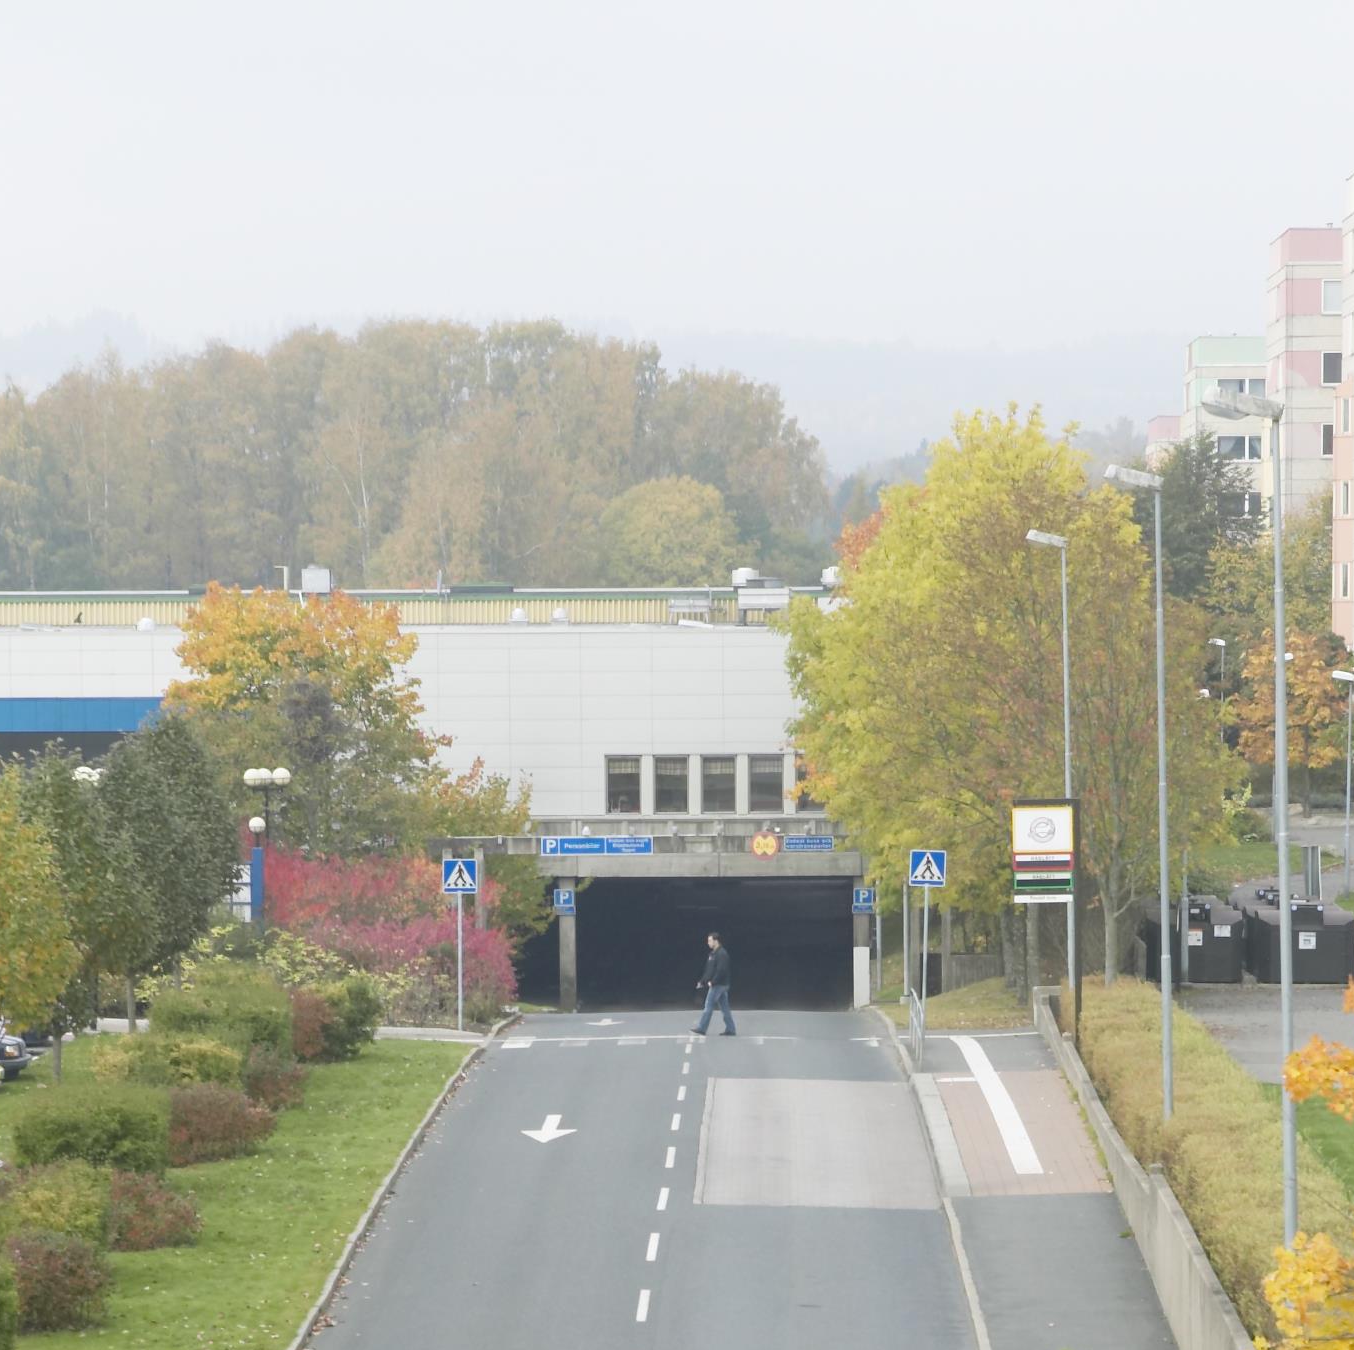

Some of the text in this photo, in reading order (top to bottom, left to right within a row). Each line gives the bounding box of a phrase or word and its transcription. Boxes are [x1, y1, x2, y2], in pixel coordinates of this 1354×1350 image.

[546, 840, 557, 853] P
[560, 891, 569, 904] P
[859, 890, 868, 903] P
